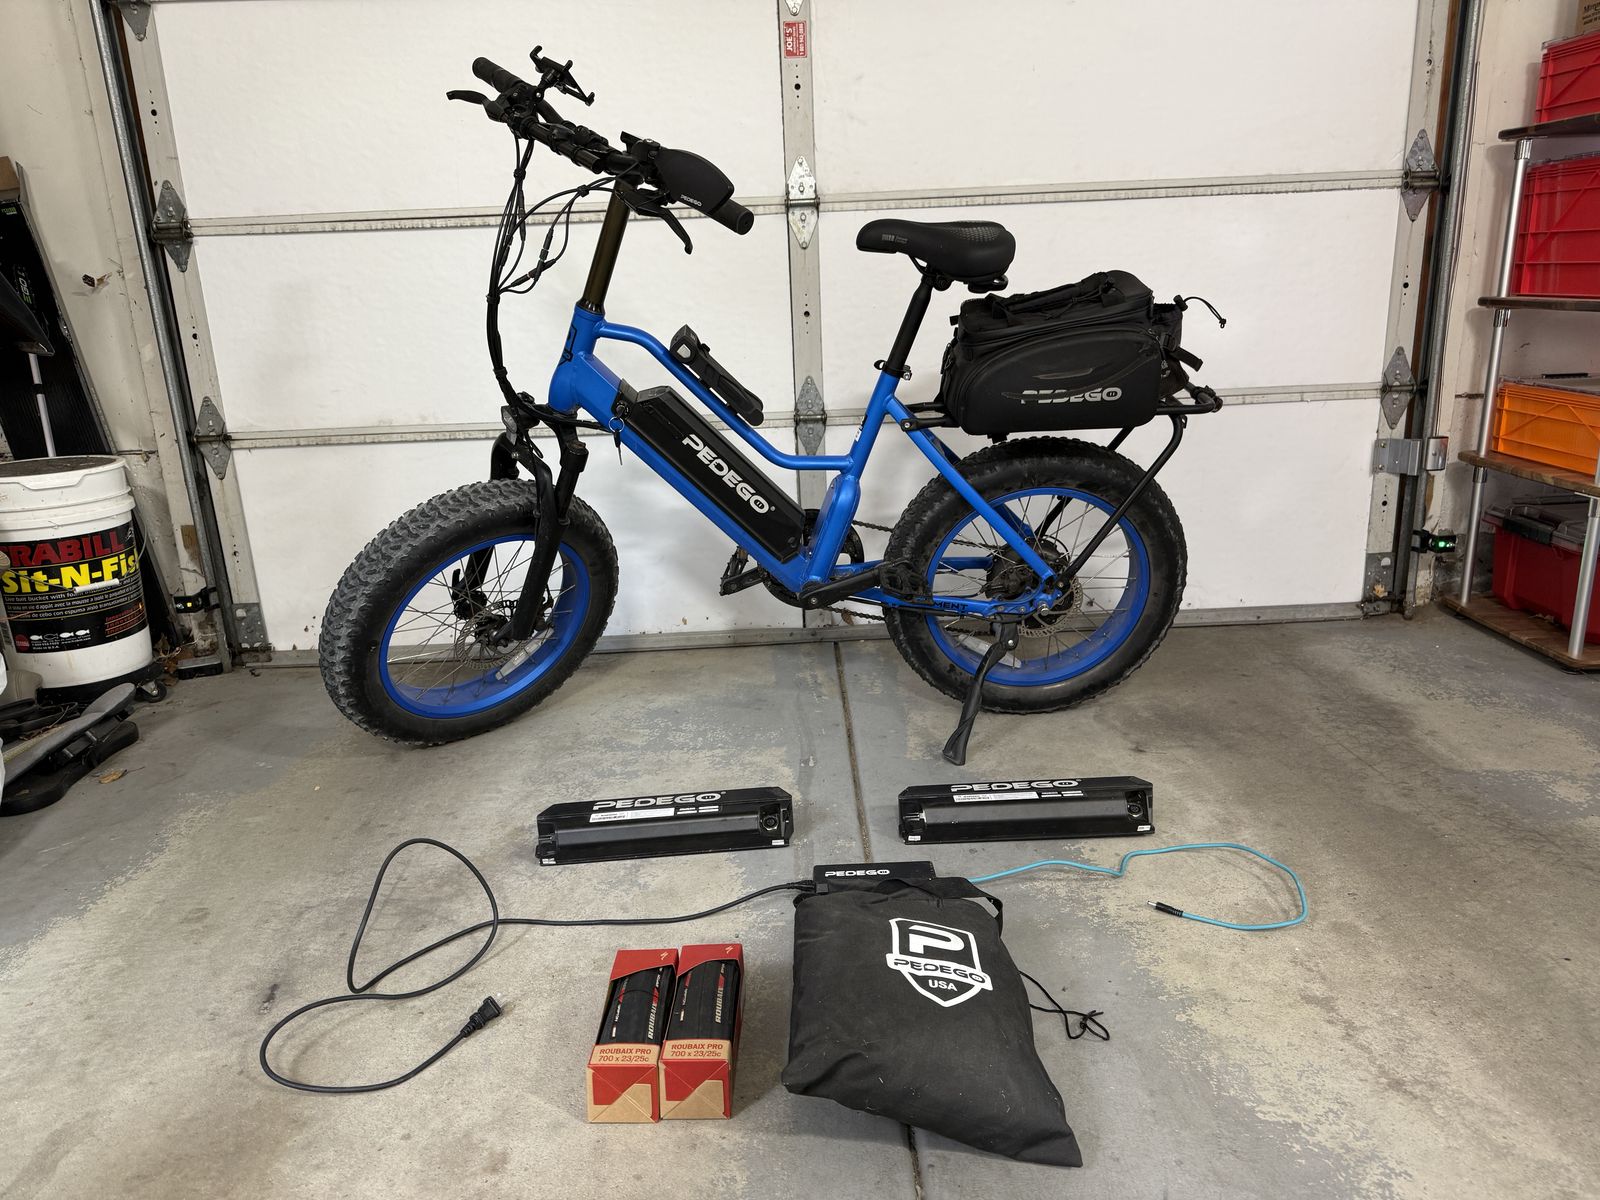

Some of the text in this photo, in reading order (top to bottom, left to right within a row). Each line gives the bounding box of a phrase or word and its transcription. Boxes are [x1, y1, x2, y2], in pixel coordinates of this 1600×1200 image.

[682, 433, 769, 514] PEDEGO
[951, 780, 1079, 792] PEDEGO
[592, 793, 721, 811] PEDEGO
[824, 869, 890, 877] PEDEGO
[908, 925, 965, 954] P
[893, 958, 986, 984] PEDEGO
[928, 979, 958, 992] USA
